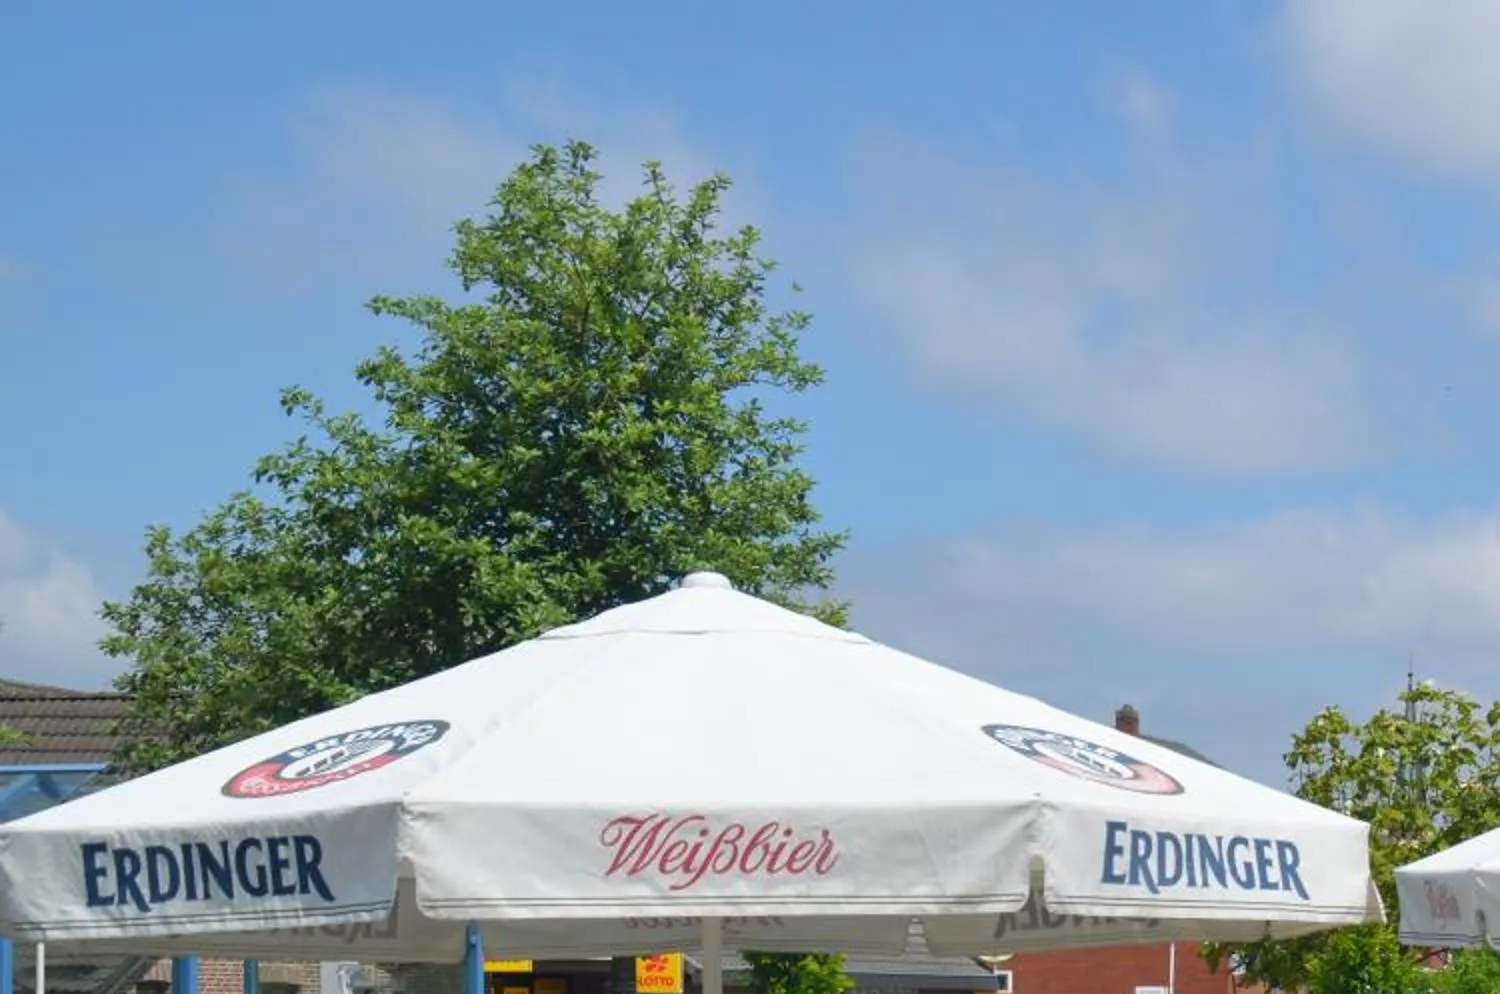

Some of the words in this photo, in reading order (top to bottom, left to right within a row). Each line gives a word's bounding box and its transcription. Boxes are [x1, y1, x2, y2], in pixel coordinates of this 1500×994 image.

[80, 835, 336, 912] ERDINGER
[601, 813, 839, 890] Weißbier
[1101, 821, 1310, 900] ERDINGER
